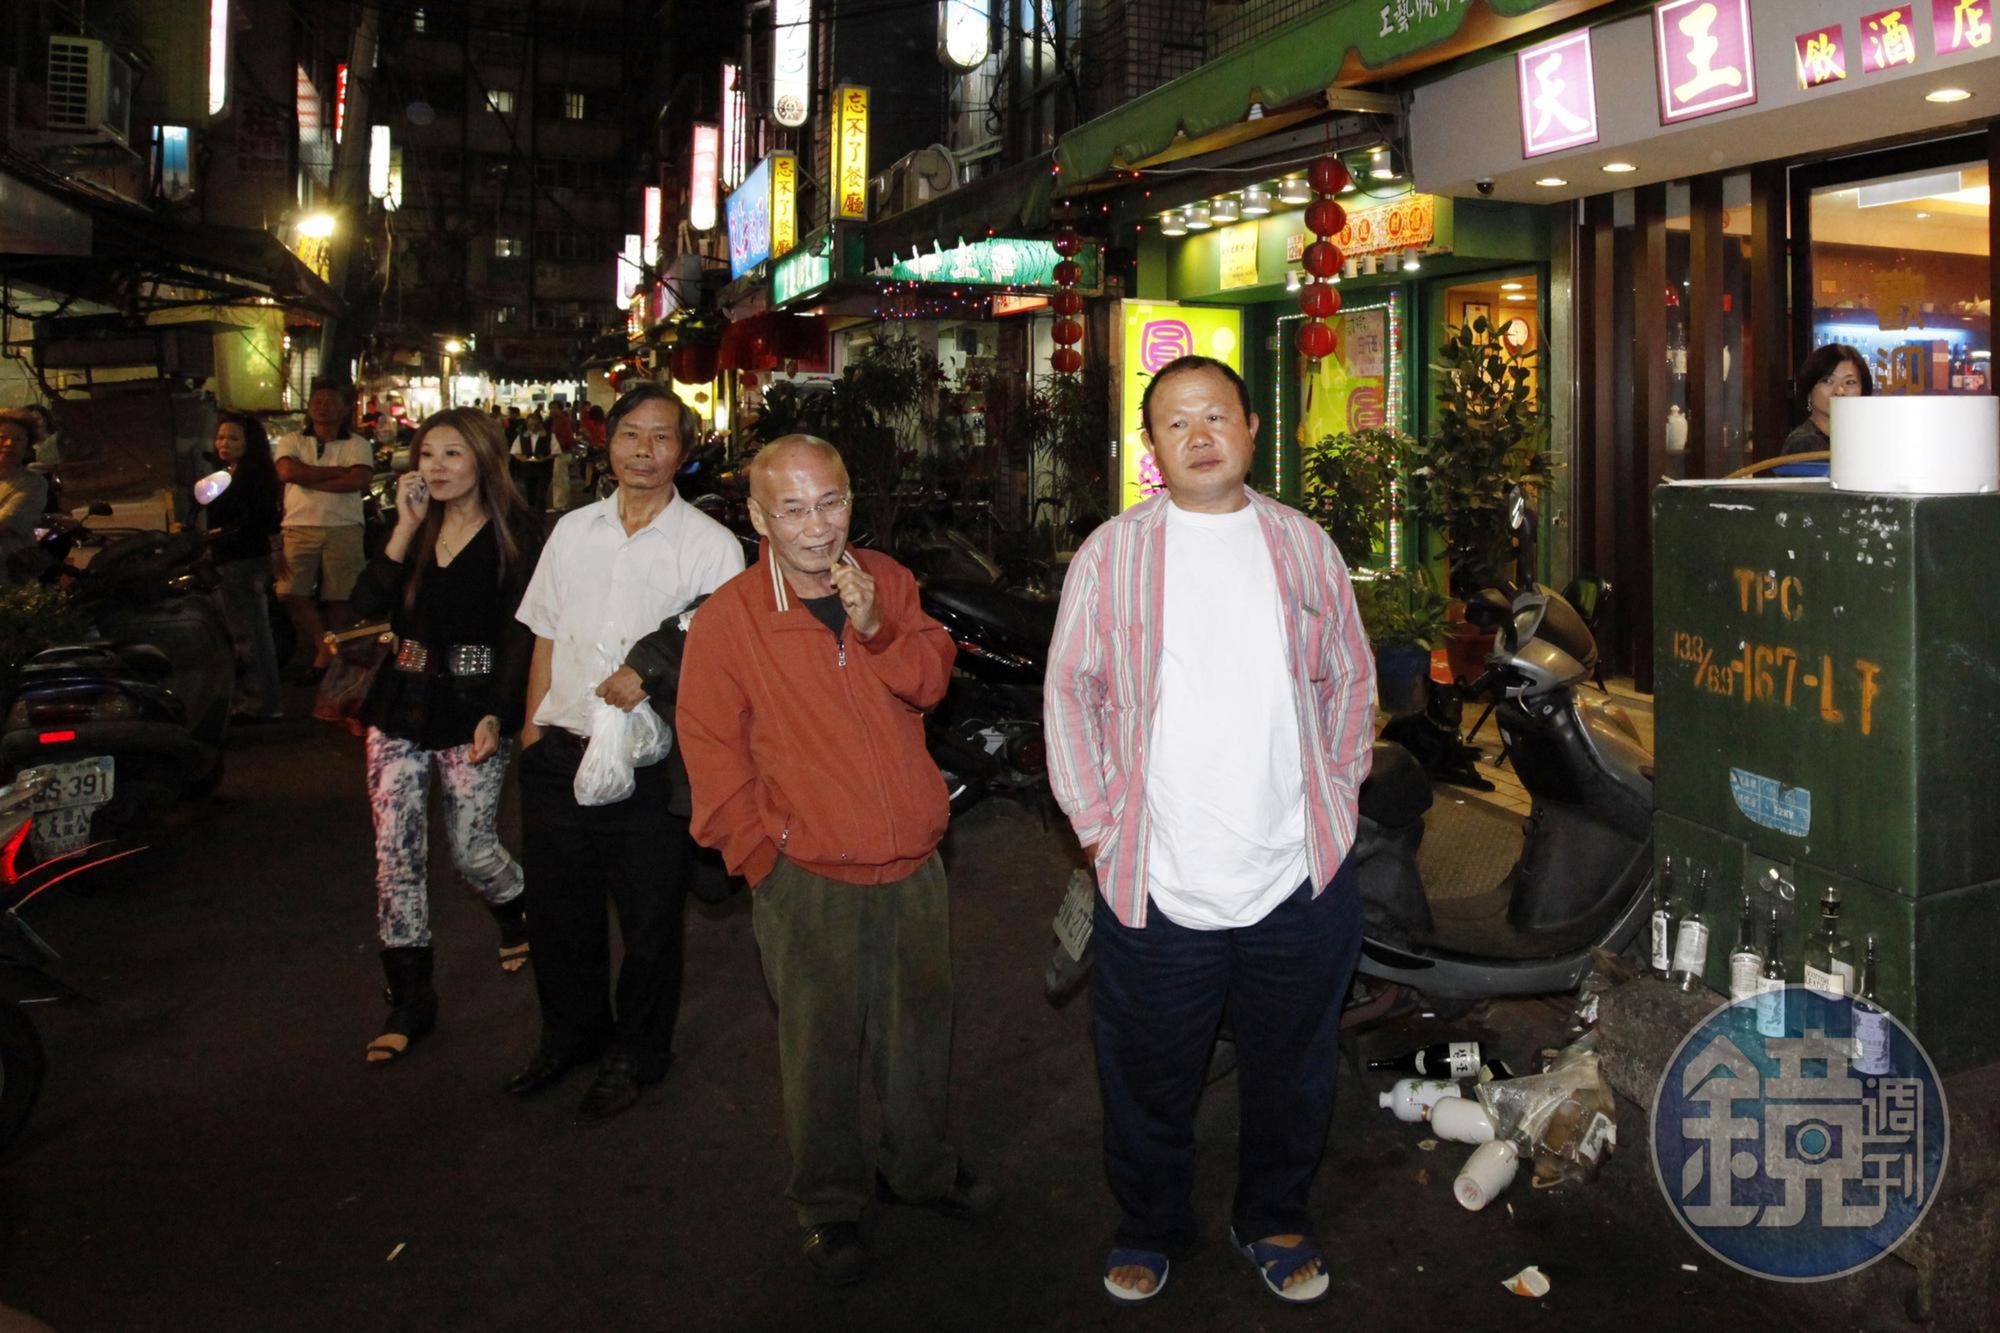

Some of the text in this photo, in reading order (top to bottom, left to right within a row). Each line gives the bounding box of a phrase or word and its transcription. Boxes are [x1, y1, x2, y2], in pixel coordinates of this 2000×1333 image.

[1531, 0, 1992, 139] 天王 飲酒店
[845, 91, 867, 214] 忘不了餐廳
[1733, 566, 1804, 622] TPC
